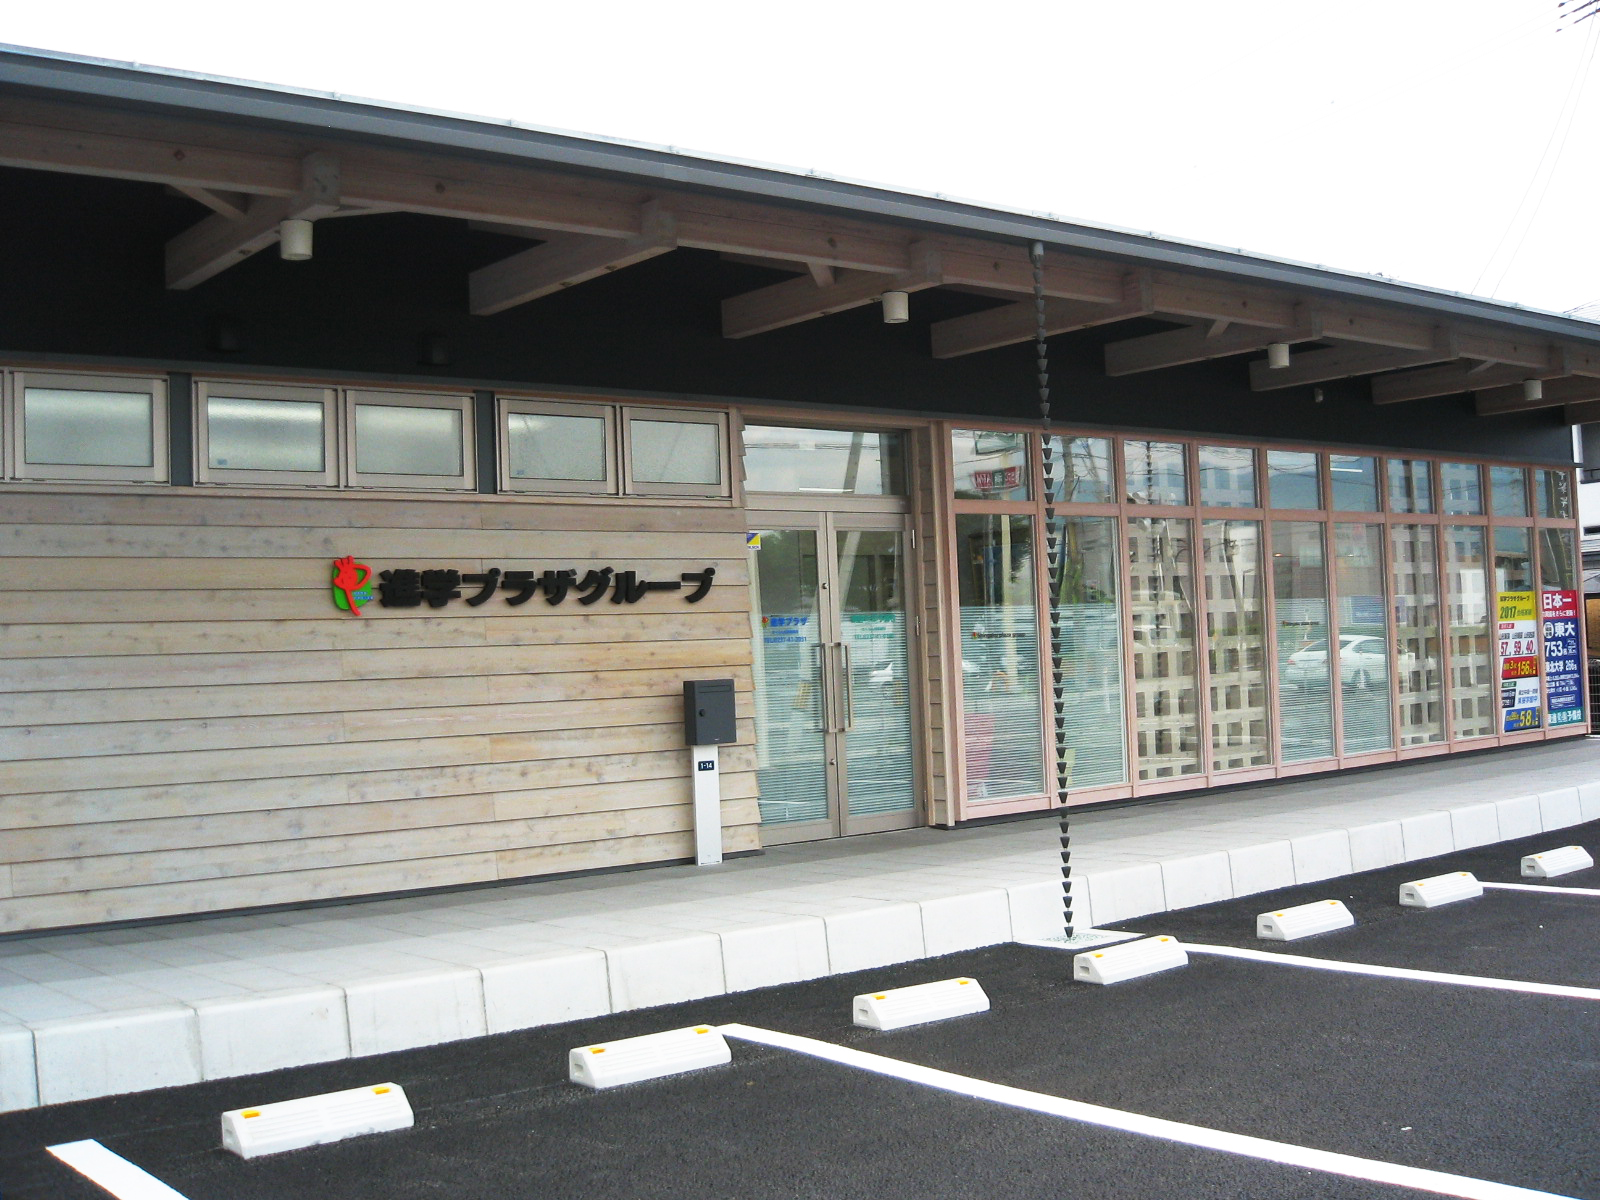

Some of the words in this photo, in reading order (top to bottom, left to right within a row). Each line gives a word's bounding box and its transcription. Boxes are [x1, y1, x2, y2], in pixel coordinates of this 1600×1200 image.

[379, 566, 716, 607] 進学プラザグループ
[1543, 593, 1572, 609] 日本一
[1500, 606, 1517, 619] 2017
[1554, 621, 1576, 637] 東大
